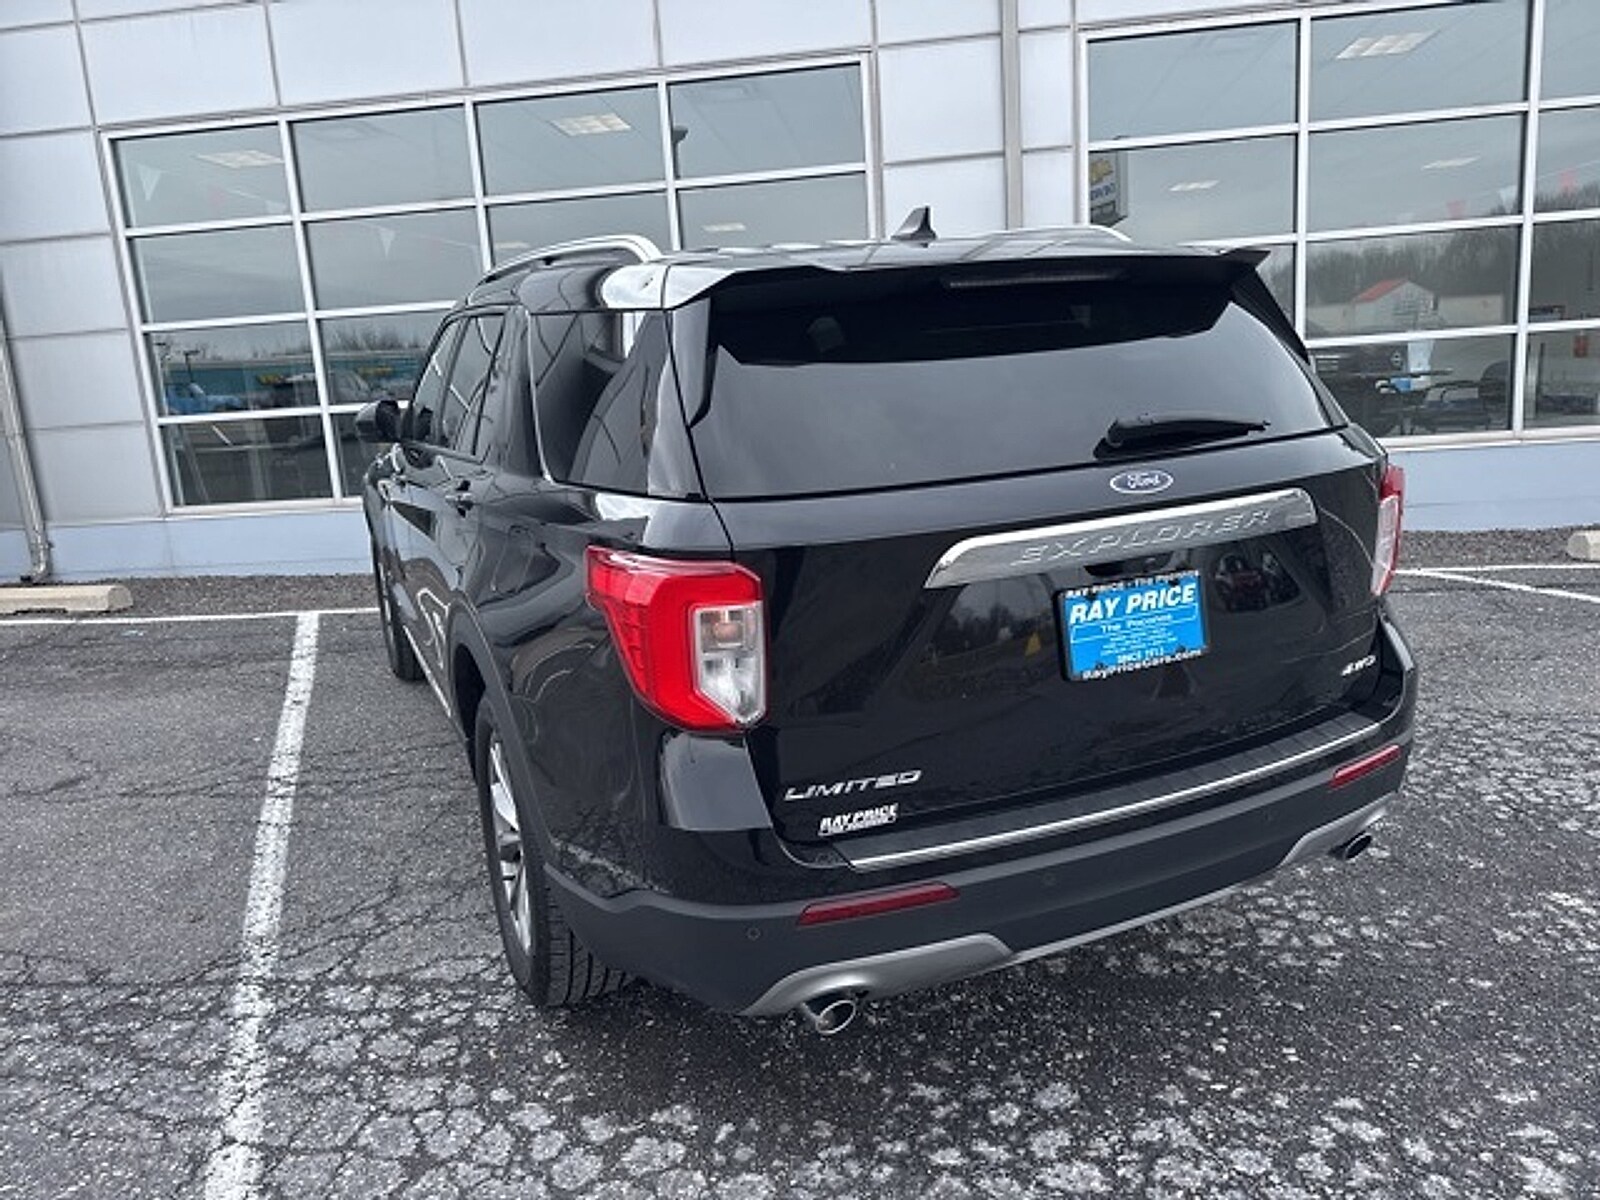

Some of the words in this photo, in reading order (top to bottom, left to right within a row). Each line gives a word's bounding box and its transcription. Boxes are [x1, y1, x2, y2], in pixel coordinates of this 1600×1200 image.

[1009, 509, 1272, 567] EXPLORER
[1070, 598, 1121, 624] RAY
[1125, 582, 1197, 614] PRICE
[1341, 654, 1377, 677] 4WD
[784, 769, 922, 801] LIMITED
[819, 812, 852, 831] RAY
[852, 803, 898, 824] PRICE
